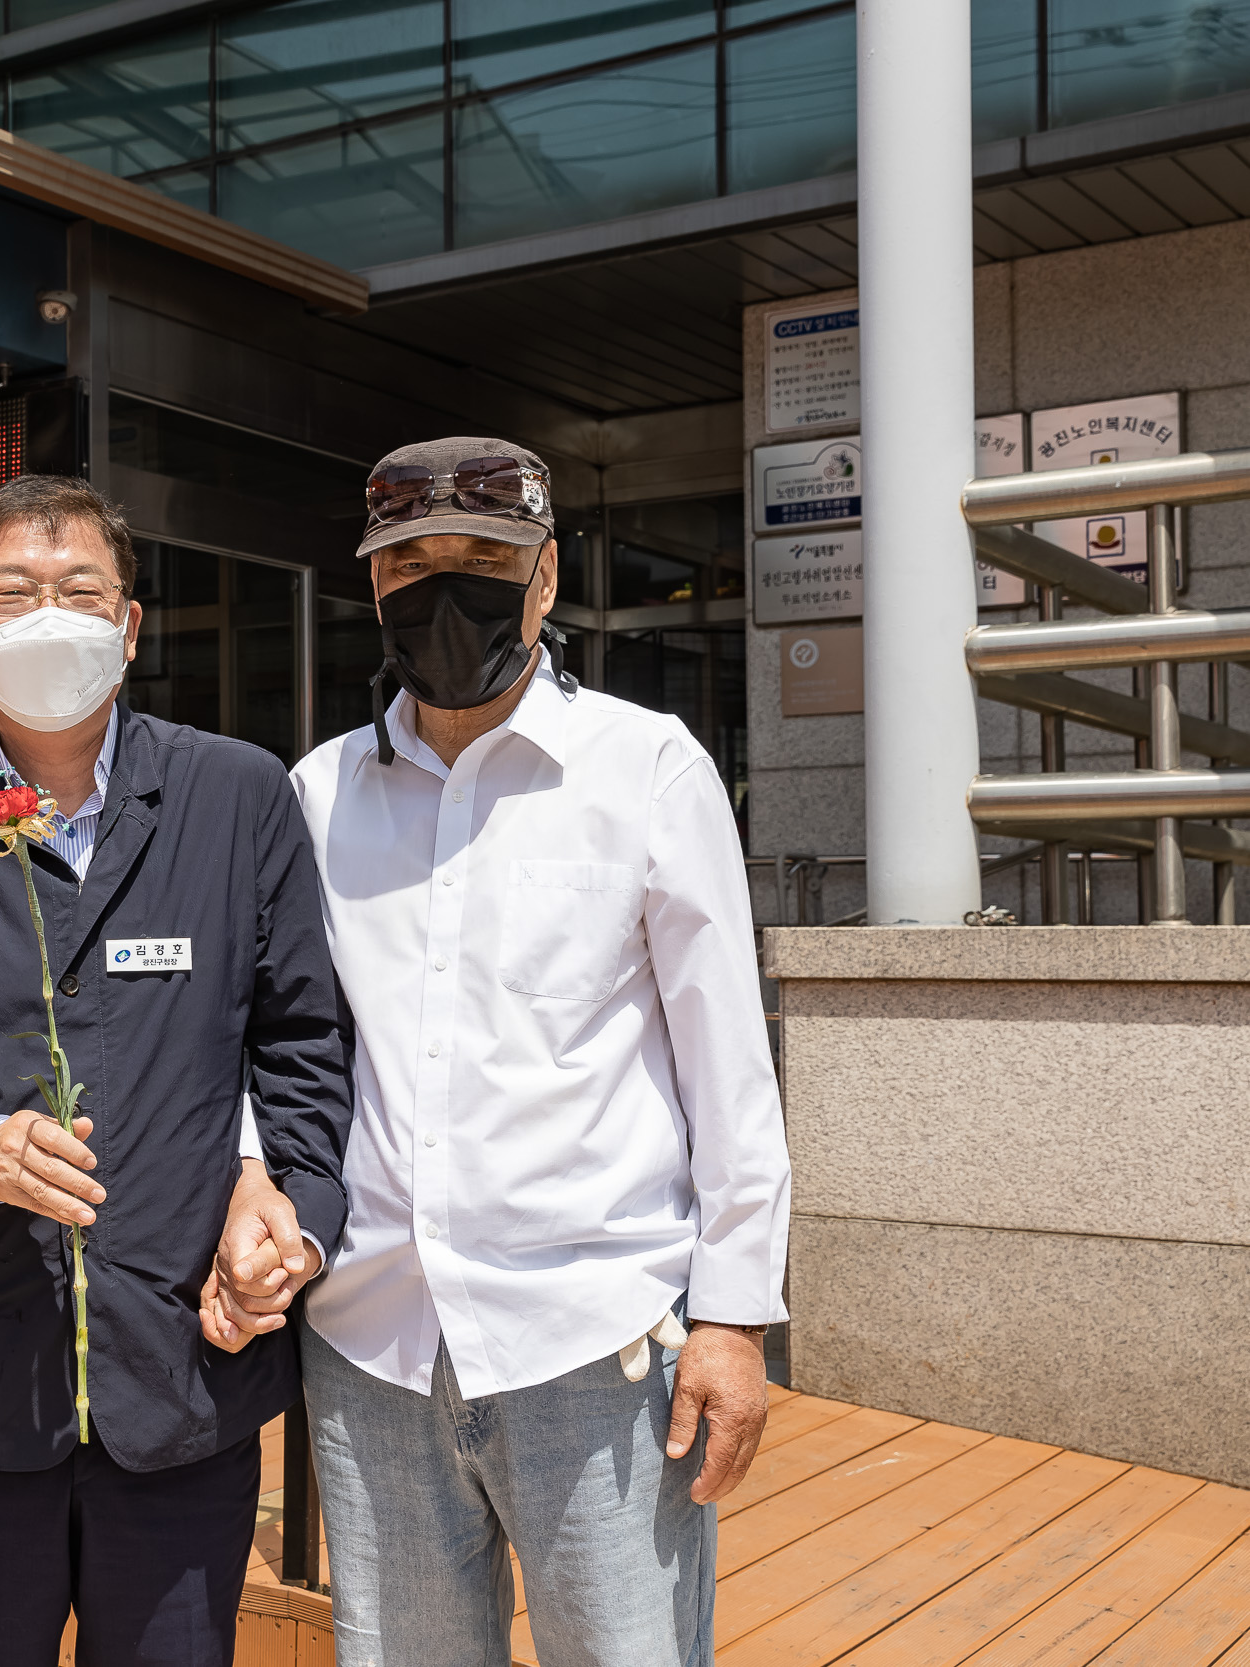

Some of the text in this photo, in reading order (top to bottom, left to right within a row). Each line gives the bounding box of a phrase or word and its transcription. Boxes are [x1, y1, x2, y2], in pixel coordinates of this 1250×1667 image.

[778, 321, 813, 336] CCTV
[1038, 416, 1173, 458] 광진노인복지센터
[142, 958, 178, 967] 광진구청장
